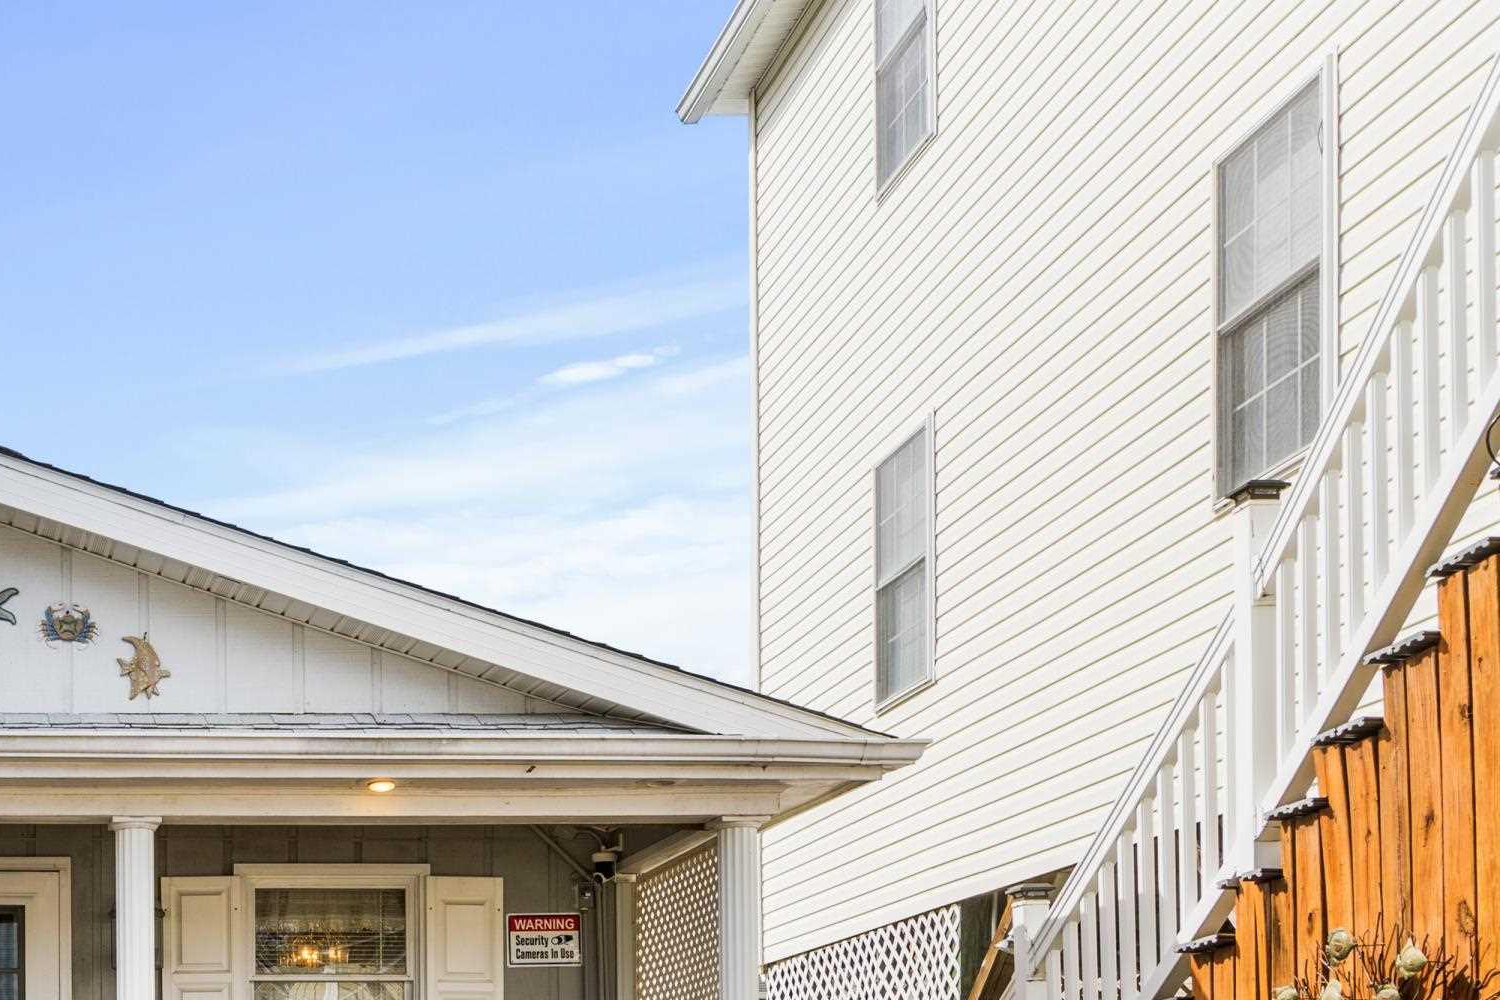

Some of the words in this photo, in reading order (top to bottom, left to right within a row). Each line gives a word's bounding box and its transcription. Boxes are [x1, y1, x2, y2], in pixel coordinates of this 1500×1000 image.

[514, 918, 575, 930] WARNING
[515, 935, 549, 947] Security
[515, 948, 549, 959] Cameras
[551, 948, 559, 959] In
[560, 948, 575, 959] Use
